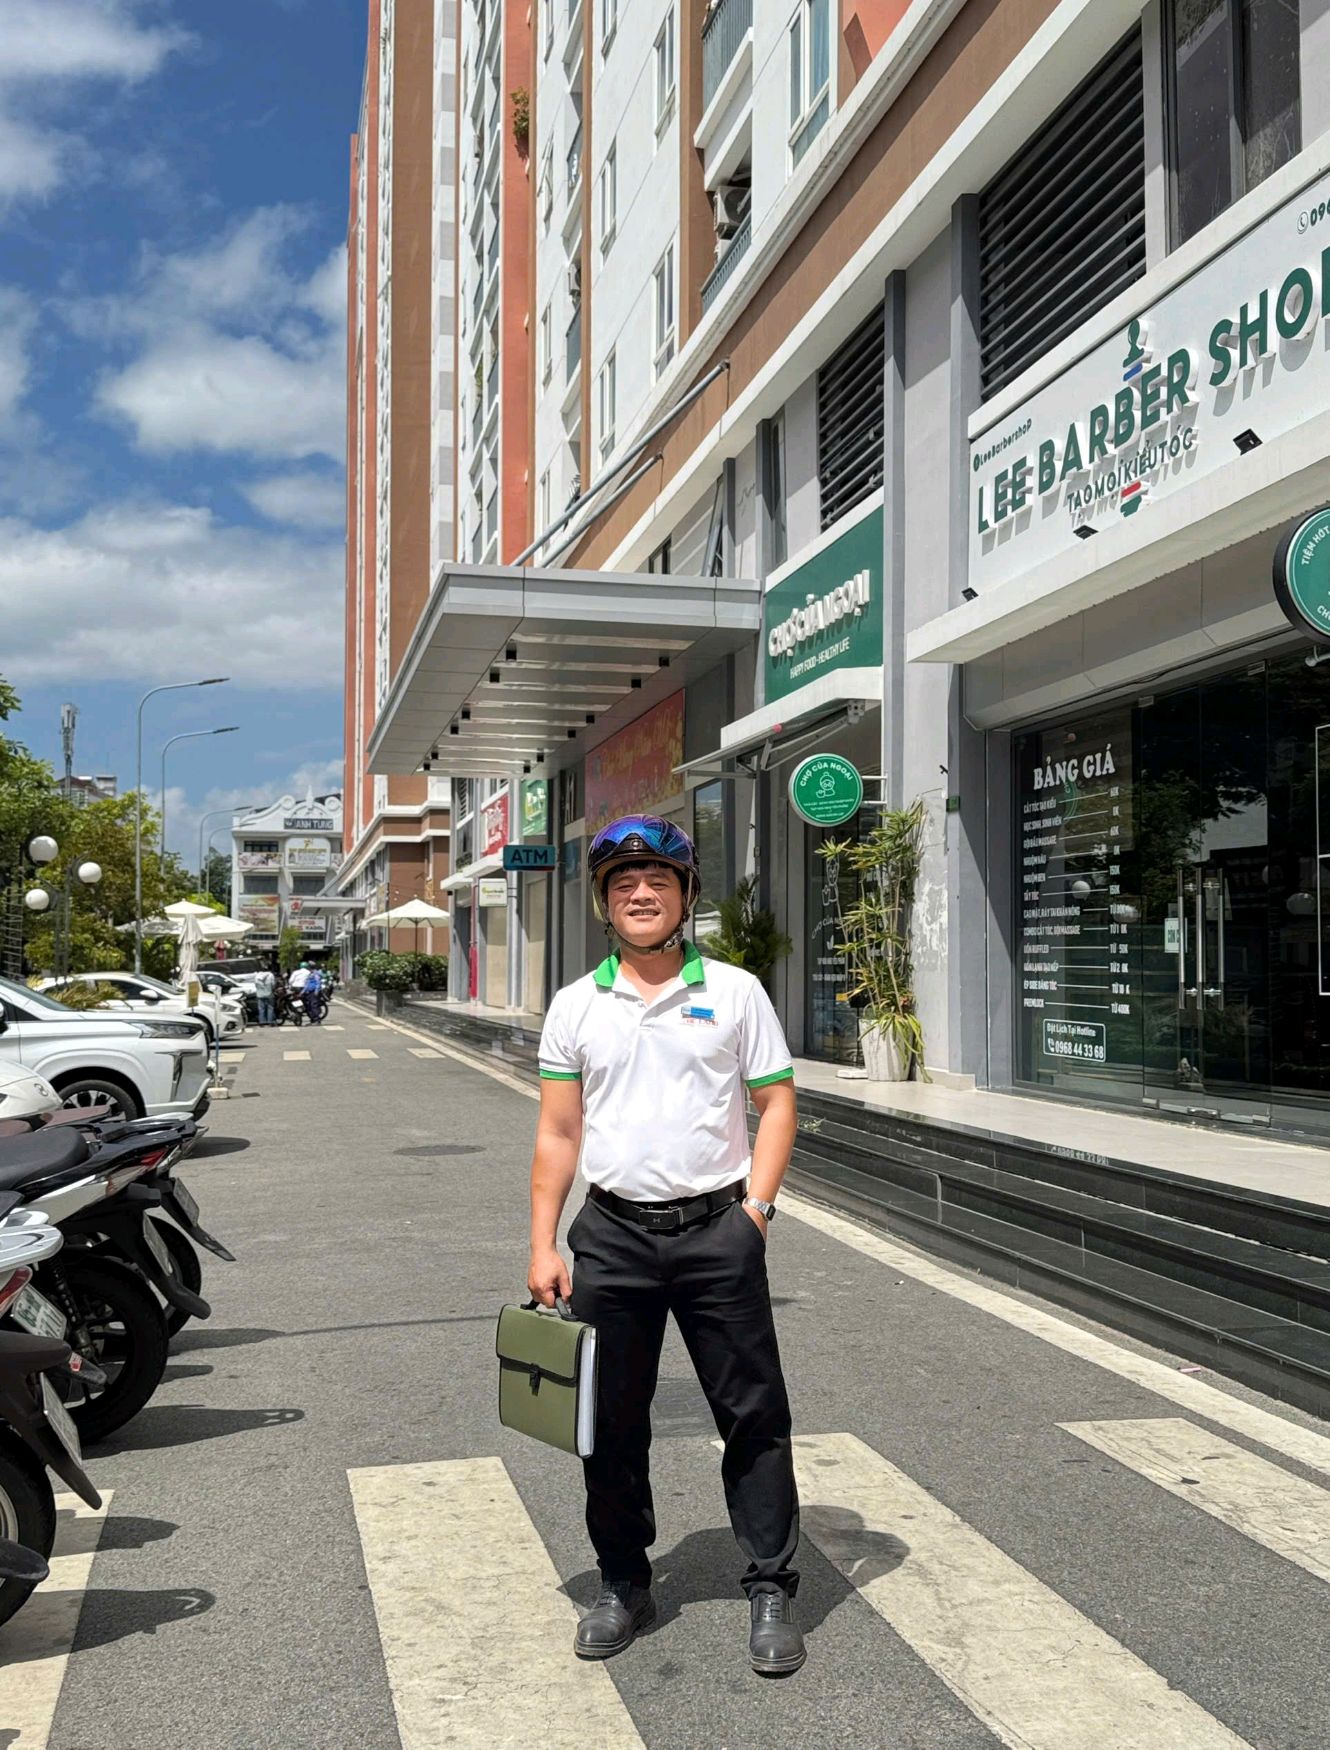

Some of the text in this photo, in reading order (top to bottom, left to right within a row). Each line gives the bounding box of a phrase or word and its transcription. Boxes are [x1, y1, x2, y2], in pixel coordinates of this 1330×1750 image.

[978, 456, 1027, 534] LEE
[1038, 348, 1191, 496] BARBER
[1033, 743, 1116, 790] BẢNG GIÁ
[511, 849, 548, 864] ATM
[1055, 1040, 1104, 1059] 0968 44 33 68
